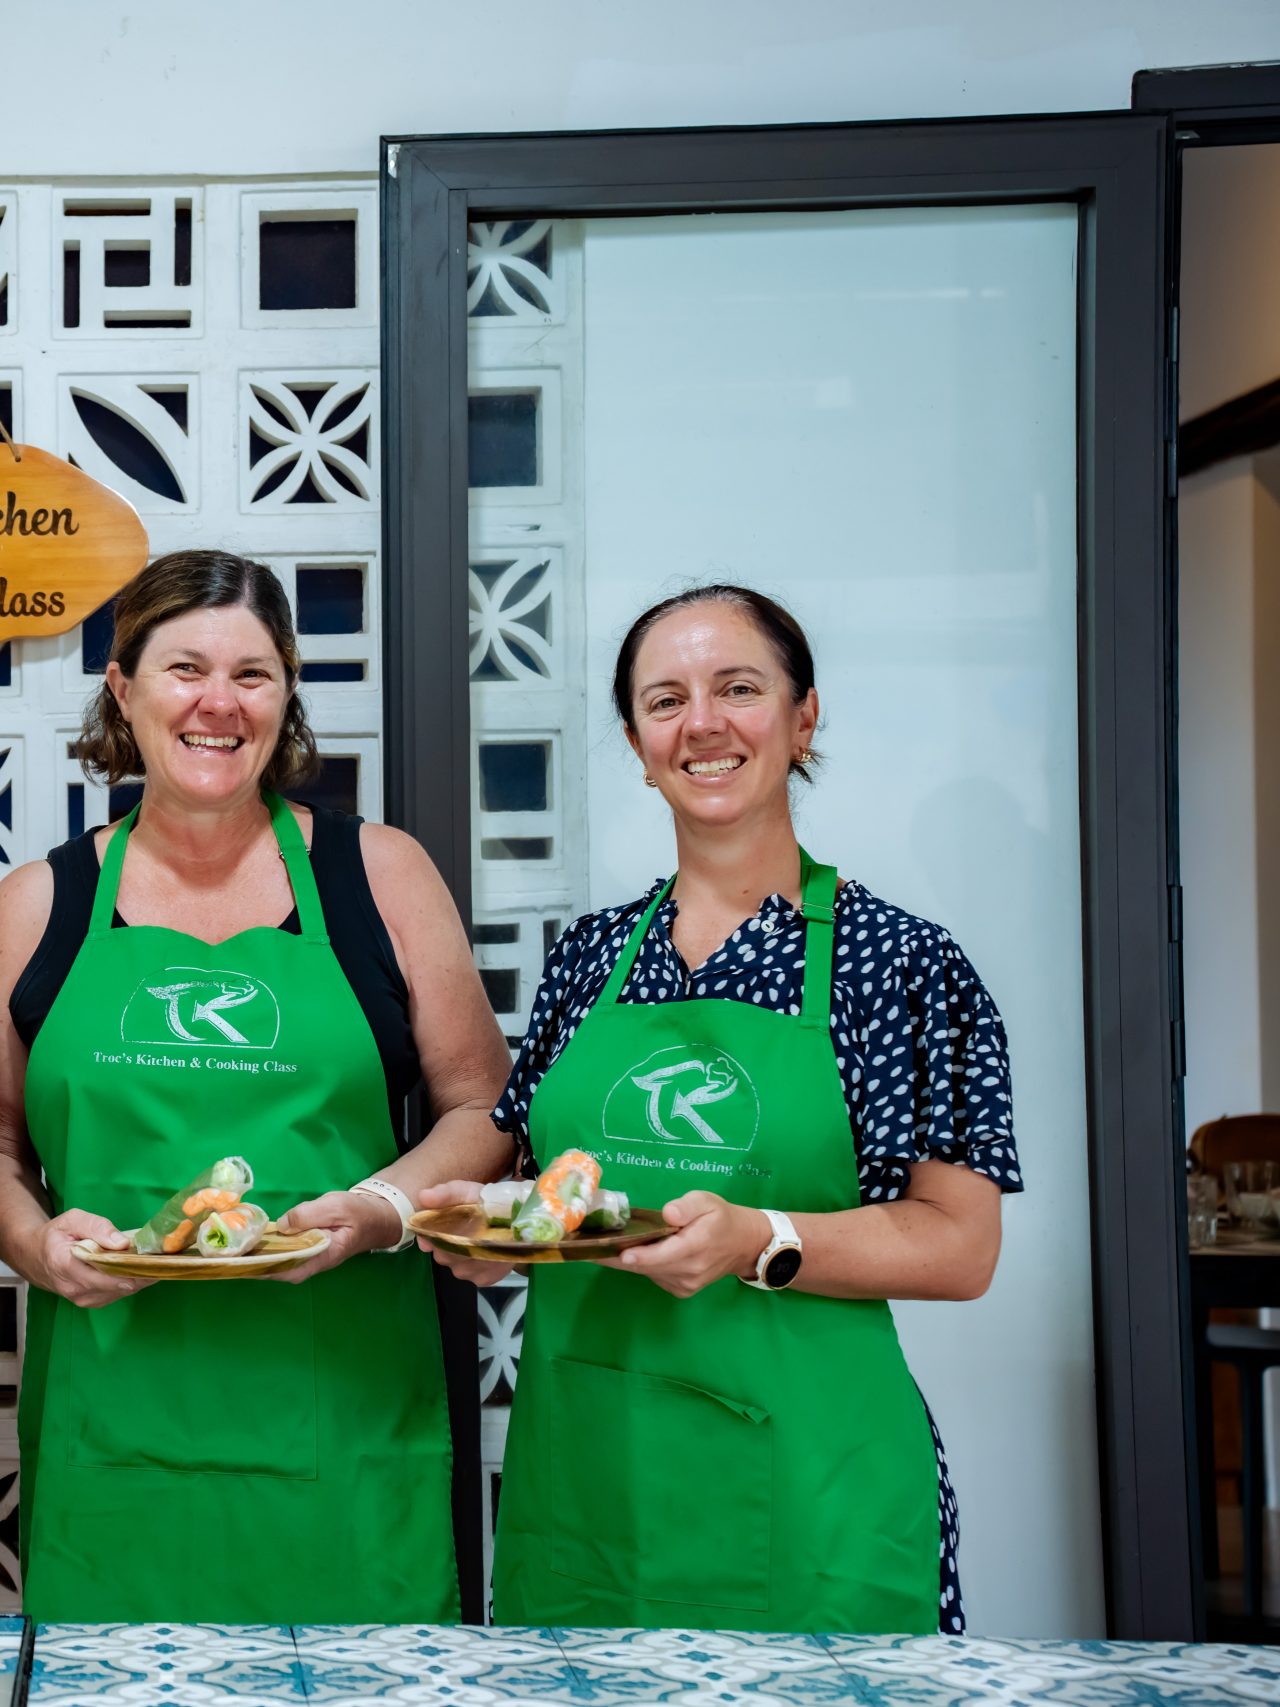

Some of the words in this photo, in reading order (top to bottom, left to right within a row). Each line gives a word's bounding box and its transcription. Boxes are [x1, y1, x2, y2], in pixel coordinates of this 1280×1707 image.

[93, 1051, 132, 1064] Troc's
[135, 1054, 186, 1068] Kitchen
[189, 1057, 201, 1069] &
[205, 1057, 260, 1074] Cooking
[263, 1060, 298, 1073] Class
[616, 1151, 662, 1168] Kitchen
[665, 1157, 676, 1169] &
[679, 1158, 733, 1176] Cooking
